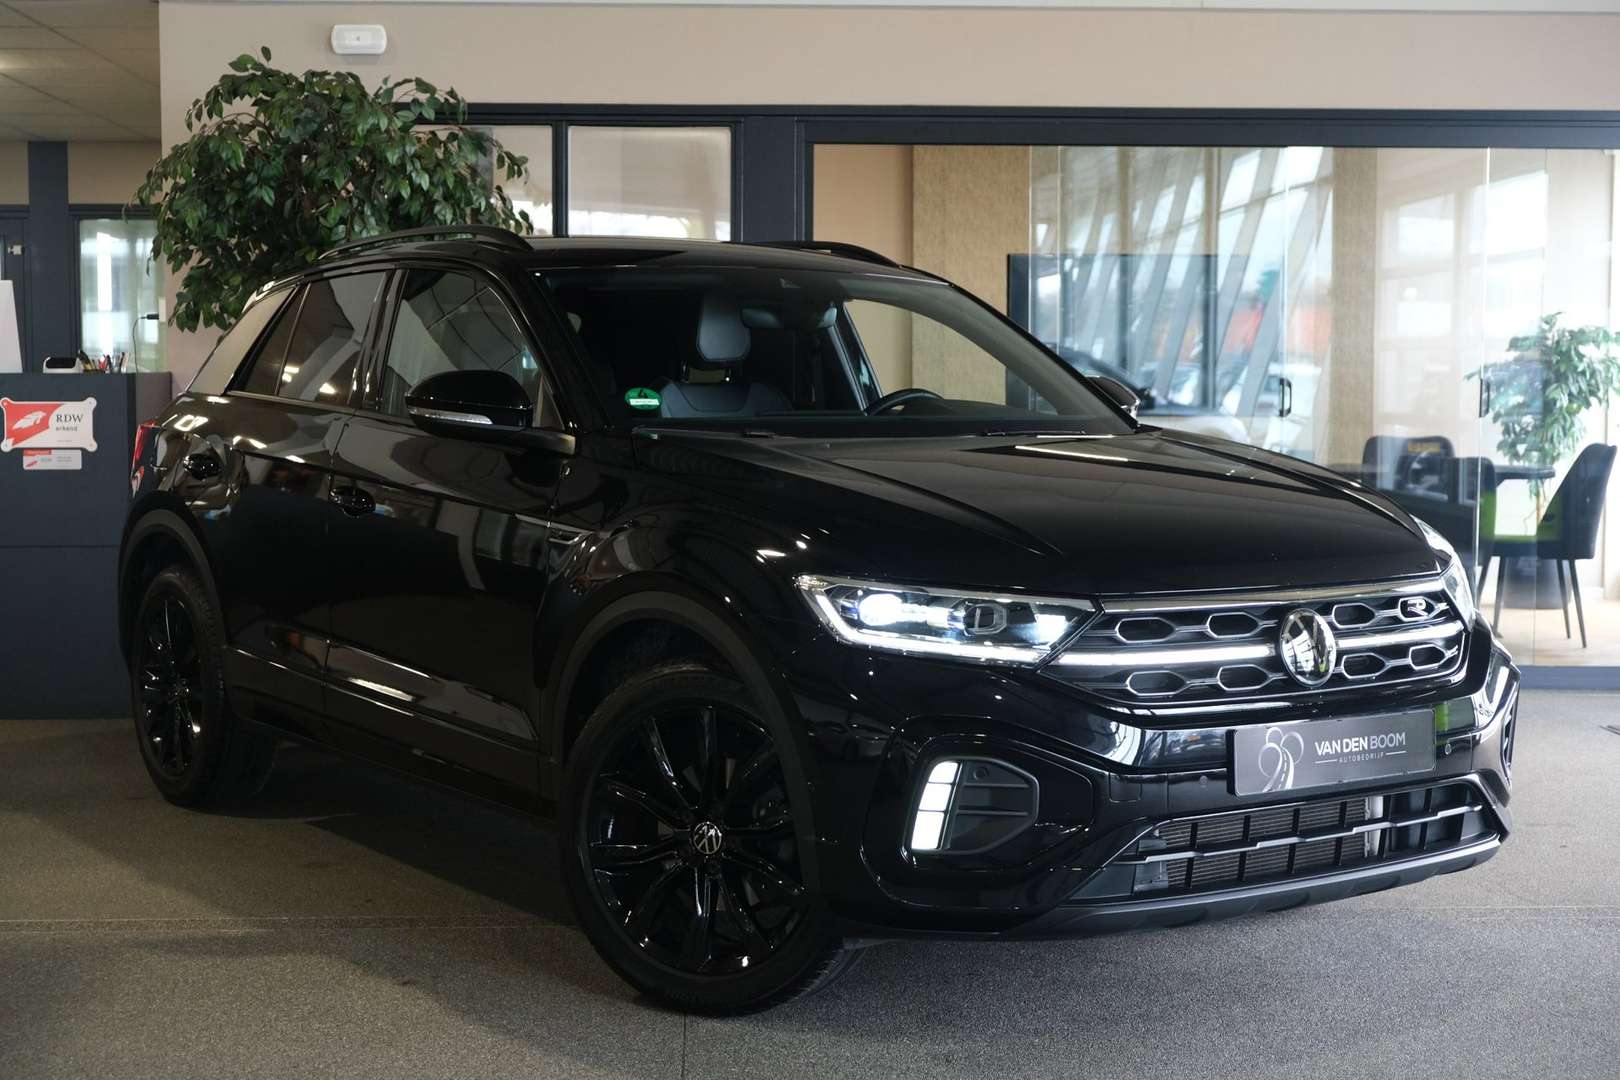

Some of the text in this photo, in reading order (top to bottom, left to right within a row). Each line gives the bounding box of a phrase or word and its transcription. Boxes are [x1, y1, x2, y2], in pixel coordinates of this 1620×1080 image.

[56, 413, 84, 423] RDW
[1314, 732, 1406, 756] VAN DEN BOOM
[1339, 751, 1384, 763] AUTOBEDRIJF
